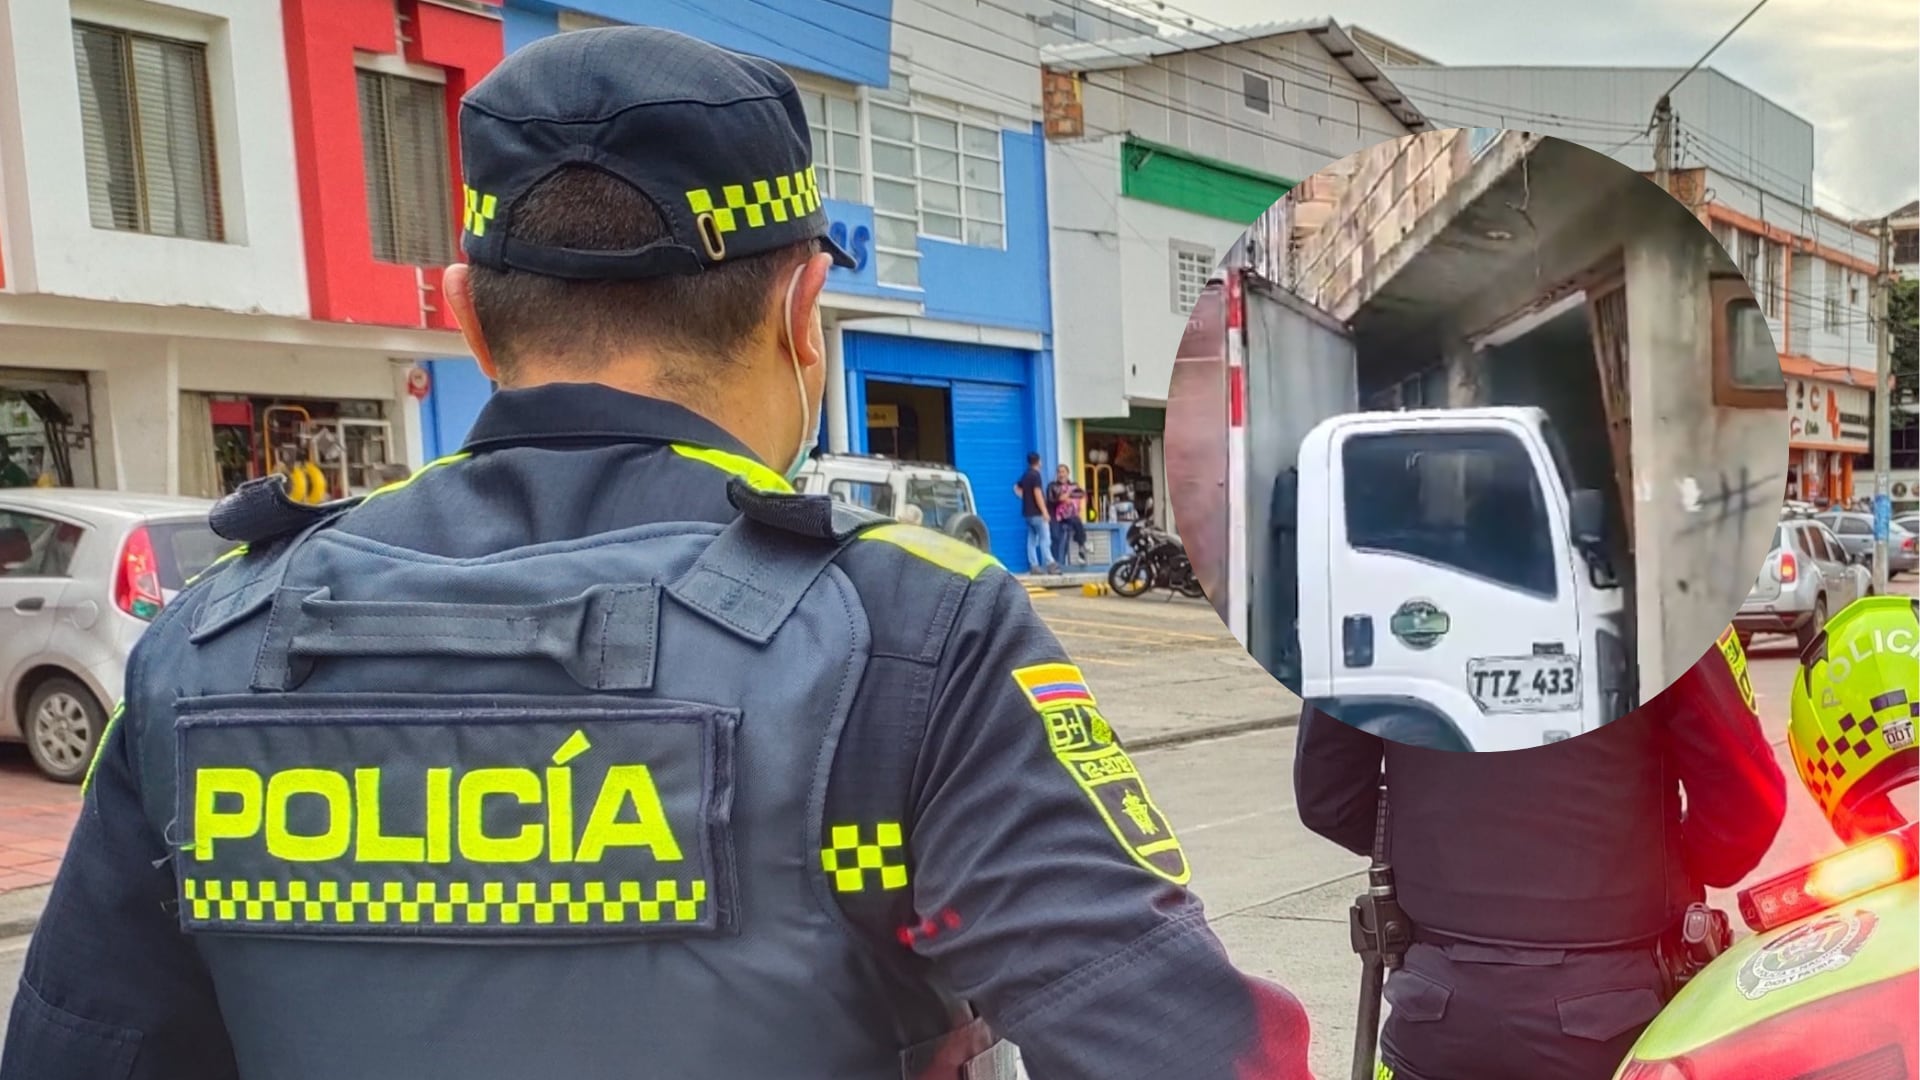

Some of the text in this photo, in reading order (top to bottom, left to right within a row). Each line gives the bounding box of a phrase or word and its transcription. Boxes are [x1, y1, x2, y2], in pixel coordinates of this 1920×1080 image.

[1473, 668, 1574, 698] TTZ 433
[1821, 628, 1919, 708] POLIC
[1050, 711, 1080, 746] B+
[194, 729, 683, 863] POLICÍA
